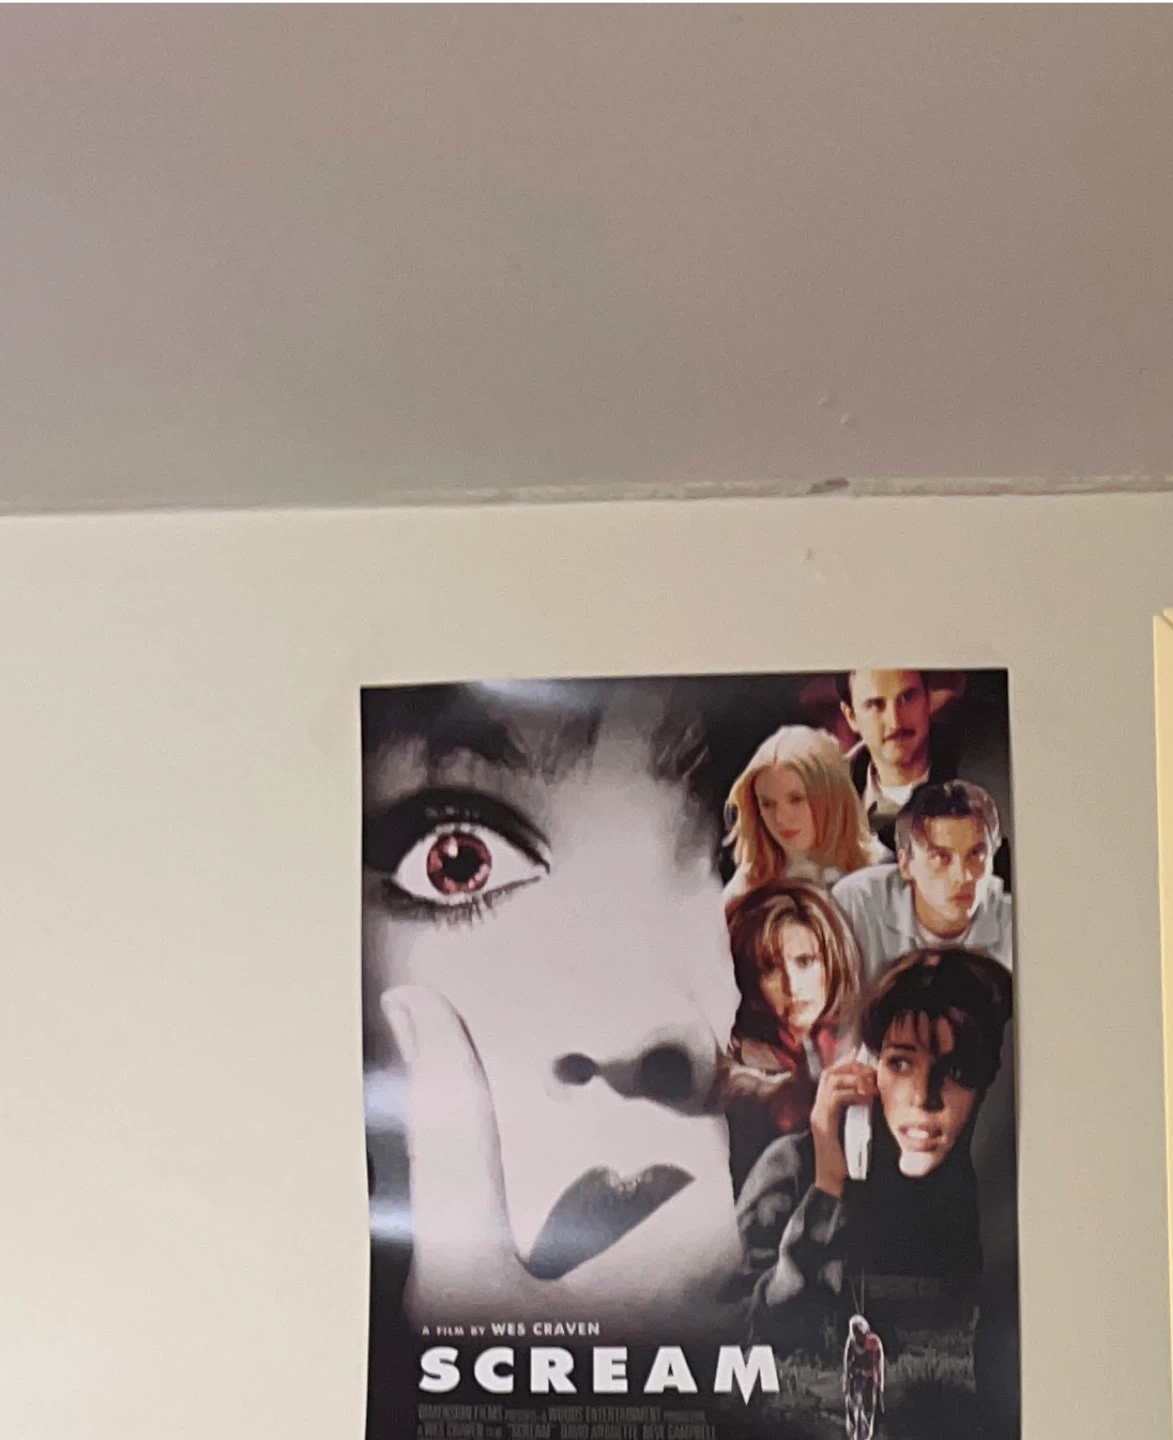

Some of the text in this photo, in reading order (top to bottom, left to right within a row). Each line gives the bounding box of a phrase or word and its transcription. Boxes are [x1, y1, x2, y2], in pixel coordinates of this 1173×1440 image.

[422, 1322, 601, 1337] A FILM BY WES CRAVEN
[418, 1344, 781, 1407] SCREAM
